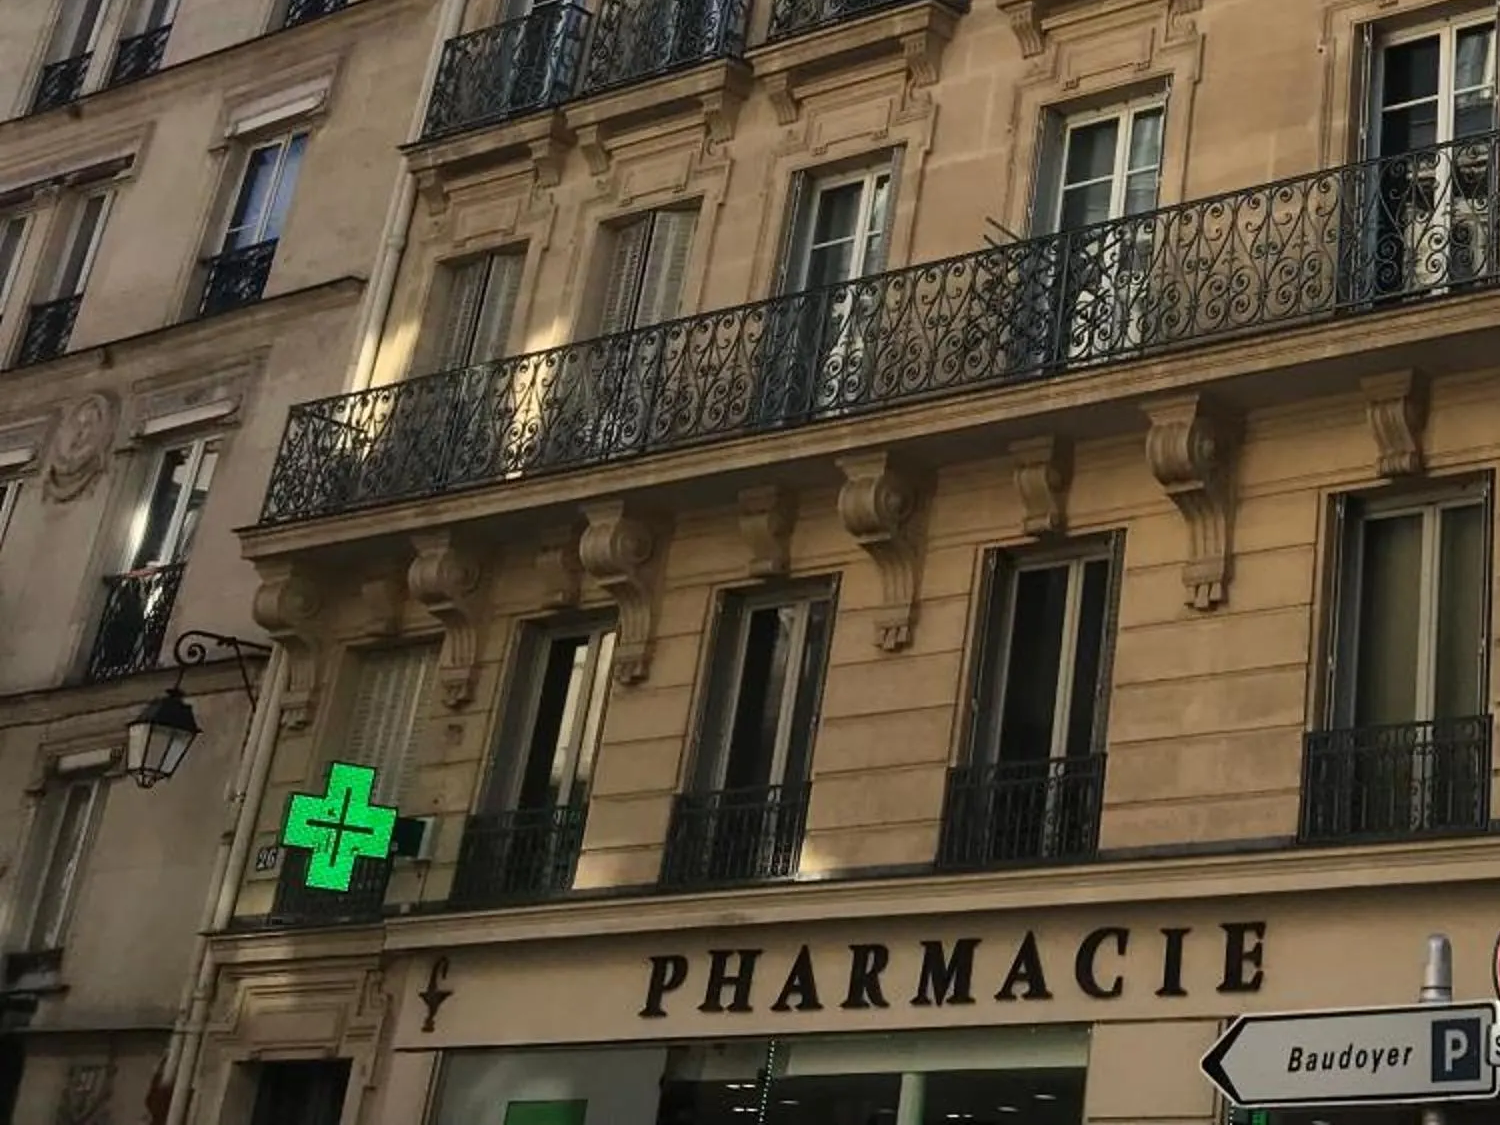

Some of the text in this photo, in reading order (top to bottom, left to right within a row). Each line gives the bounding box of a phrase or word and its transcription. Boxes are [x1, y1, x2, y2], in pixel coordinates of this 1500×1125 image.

[638, 920, 1268, 1017] PHARMACIE
[1287, 1028, 1469, 1074] Baudoyer P
